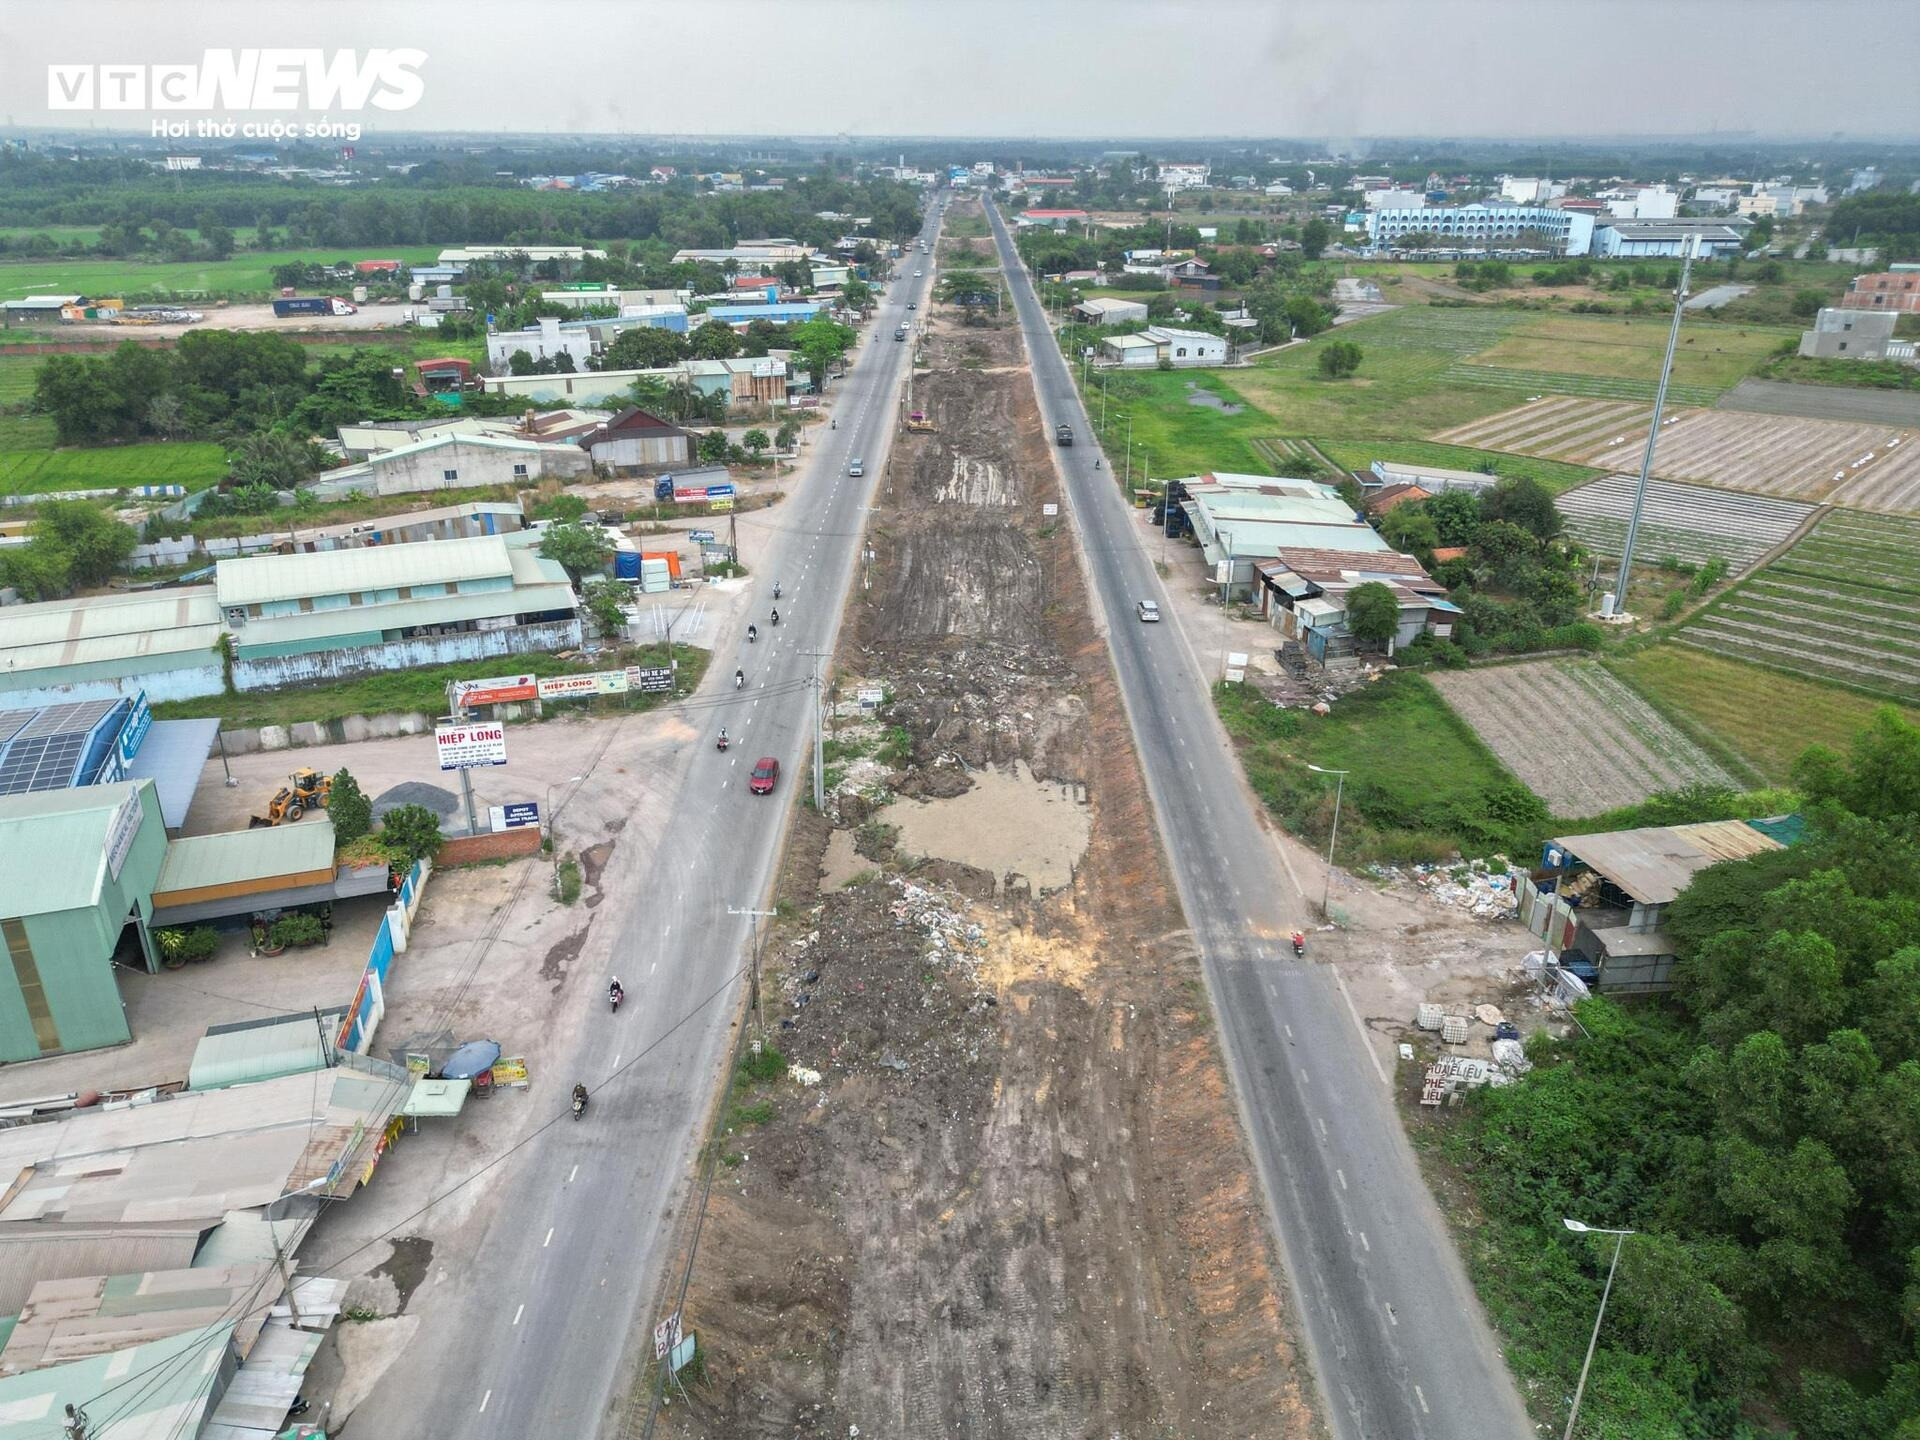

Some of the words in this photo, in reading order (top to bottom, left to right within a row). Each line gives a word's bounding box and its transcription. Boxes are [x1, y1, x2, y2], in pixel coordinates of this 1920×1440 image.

[567, 680, 593, 688] LONG
[438, 731, 466, 746] HIỆP
[470, 729, 502, 742] LONG
